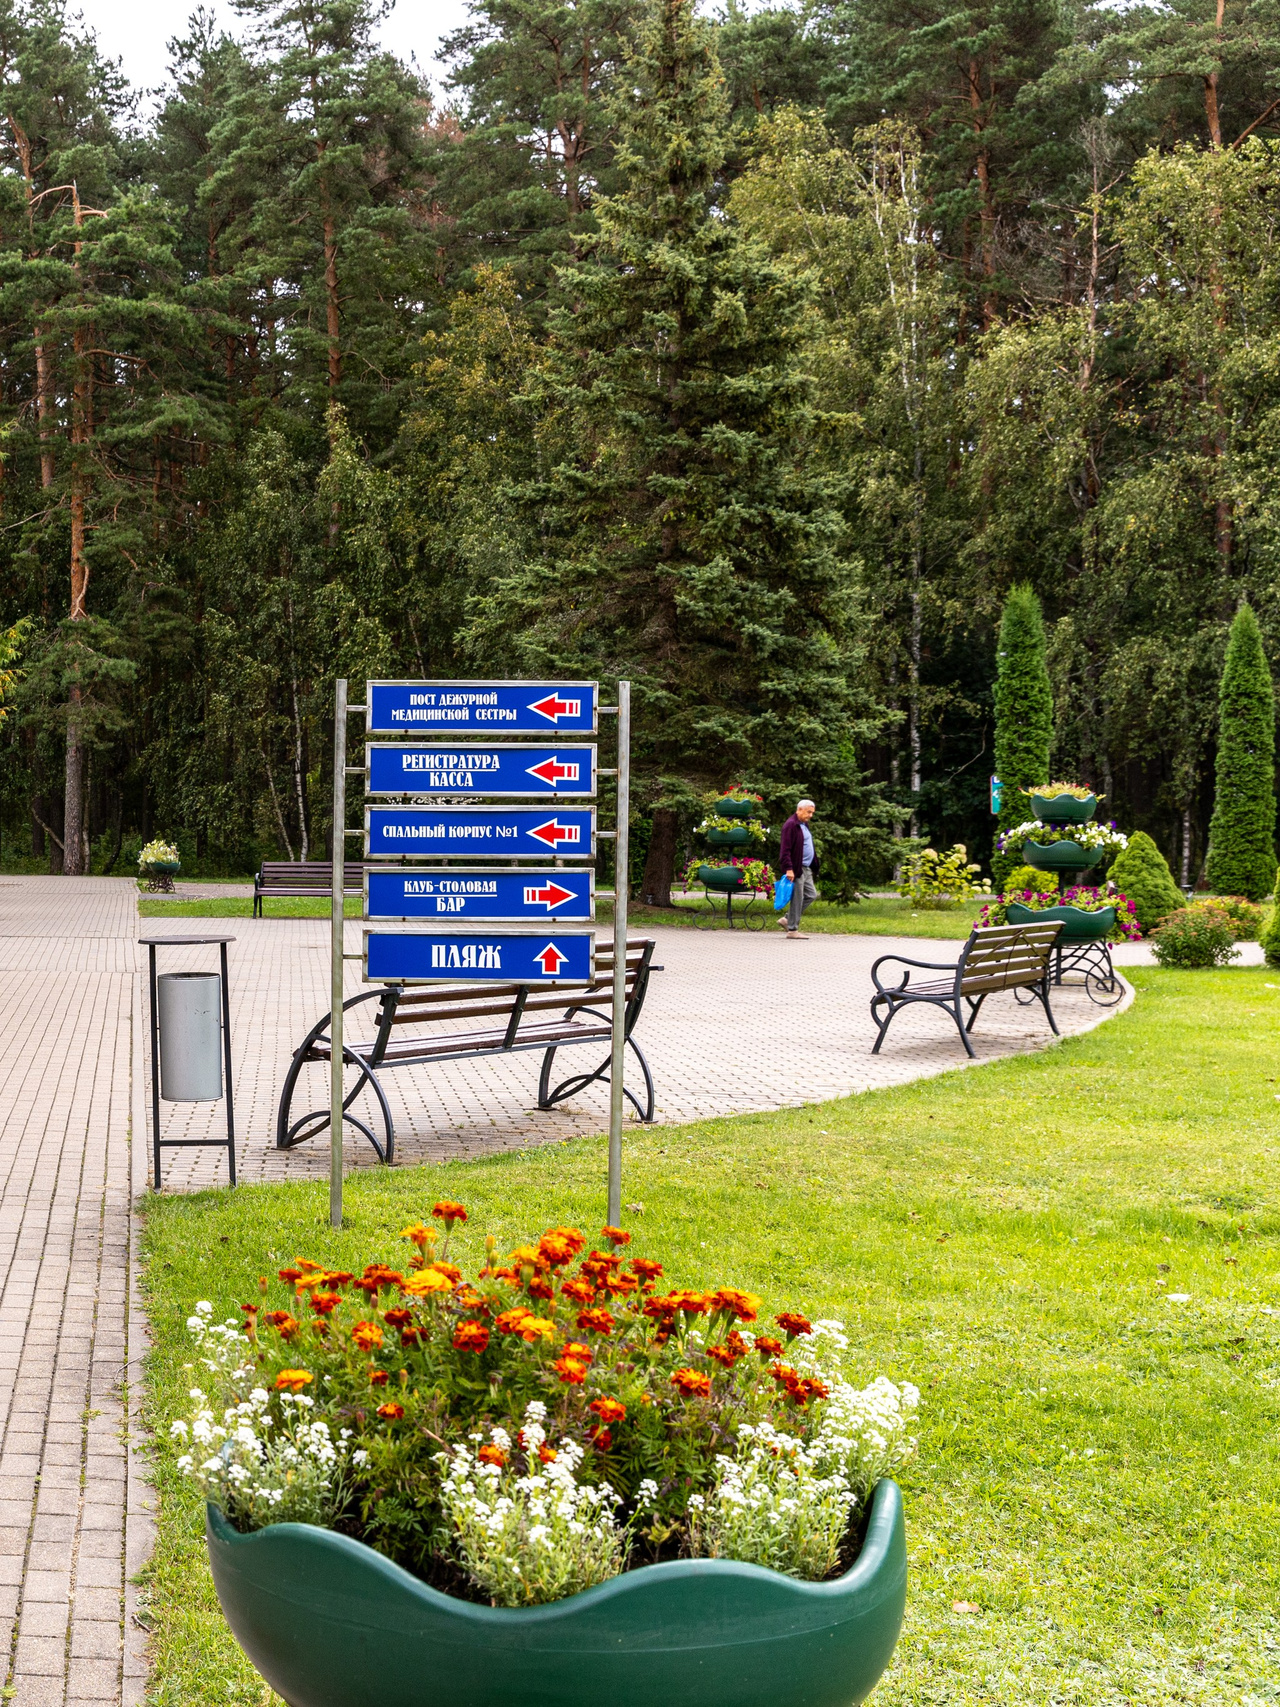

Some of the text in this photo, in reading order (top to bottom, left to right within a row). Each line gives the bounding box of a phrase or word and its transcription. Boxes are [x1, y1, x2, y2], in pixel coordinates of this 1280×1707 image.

[410, 692, 498, 706] ПОСТ ДЕЖУРНОЙ
[391, 707, 517, 721] МЕДИЦИНСКОЙ СЕСТРЫ
[402, 754, 500, 769] РЕГИСТРАТУРА
[429, 772, 474, 787] КАССА
[382, 824, 518, 838] СПАЛЬНЫЙ КОРПУС №1
[404, 881, 497, 893] КЛУБ-СТОЛОВАЯ
[436, 897, 465, 912] БАР
[431, 945, 501, 969] ПЛЯЖ
